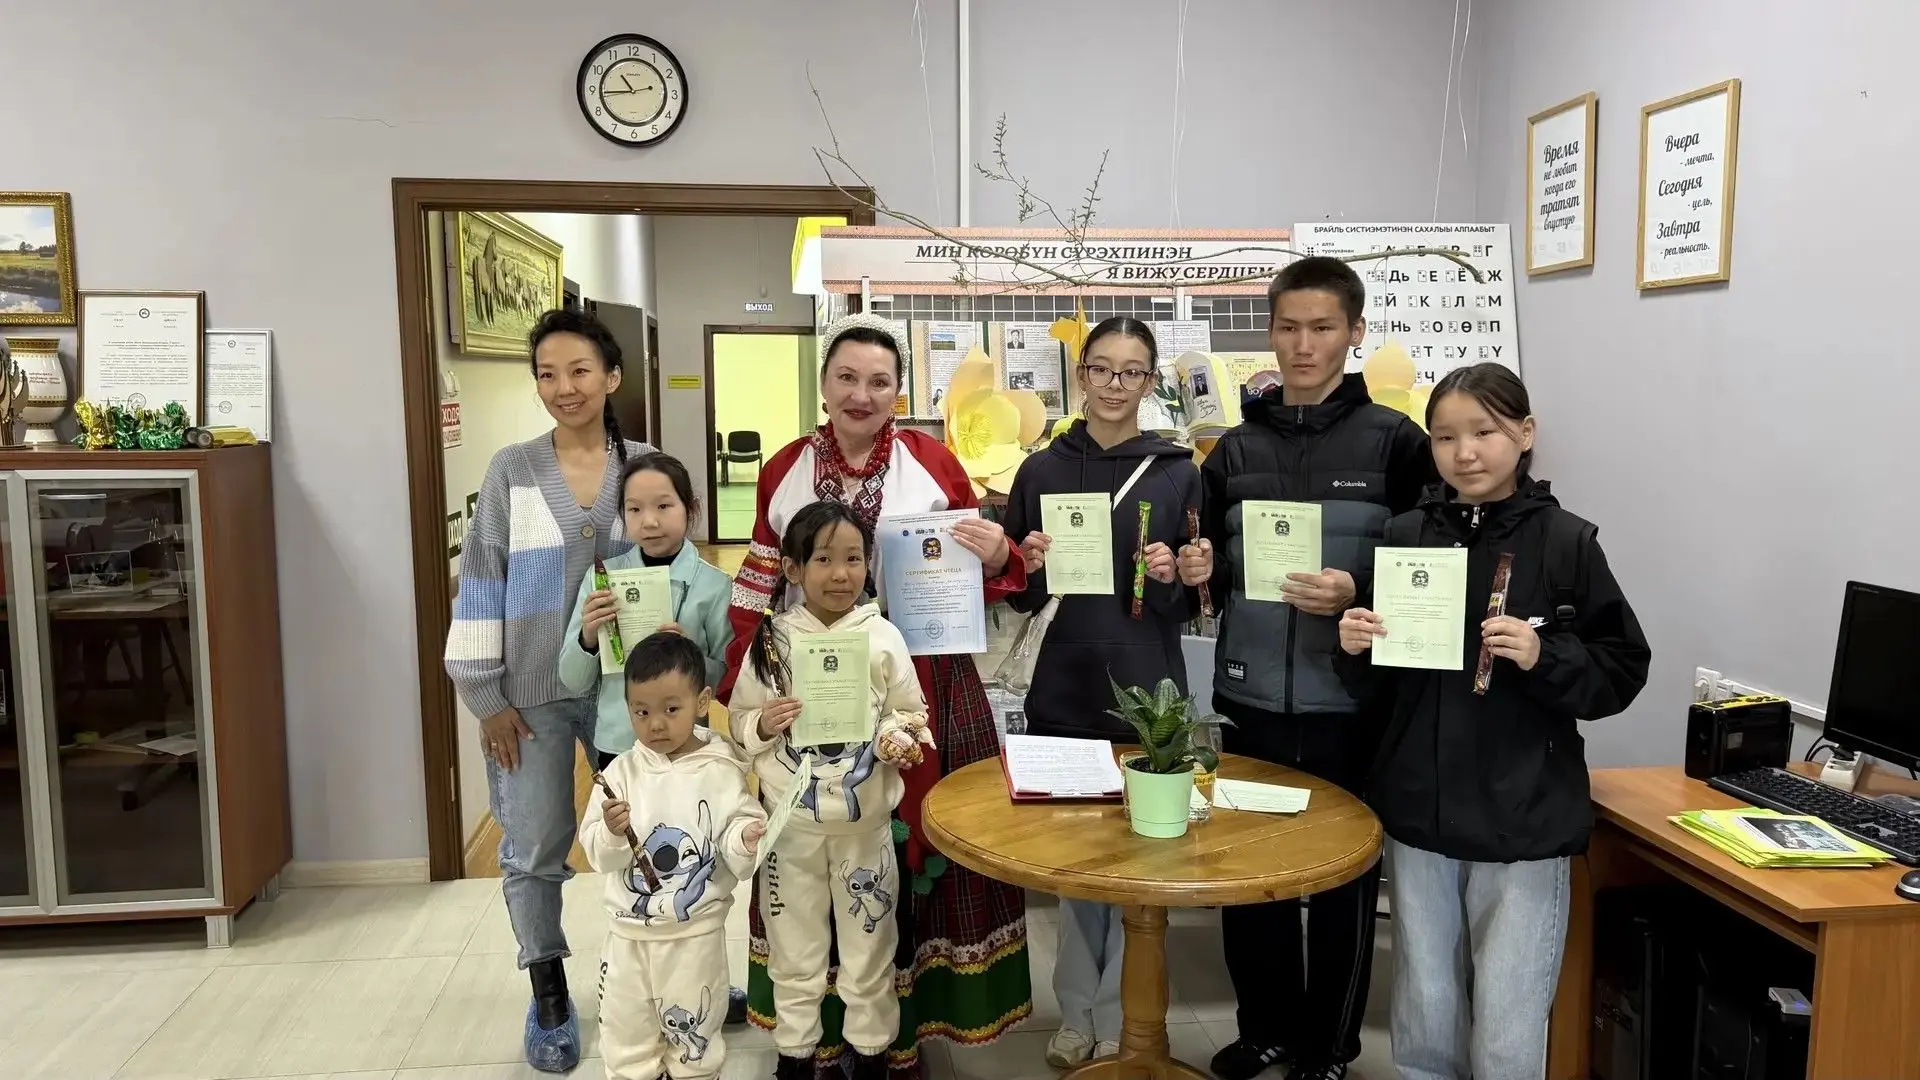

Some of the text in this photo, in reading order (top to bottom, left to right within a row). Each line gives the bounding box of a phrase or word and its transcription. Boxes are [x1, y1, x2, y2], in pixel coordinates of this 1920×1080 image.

[608, 50, 617, 60] 11
[627, 46, 639, 56] 12
[652, 54, 656, 63] 1
[593, 65, 603, 75] 10
[666, 69, 673, 79] 2
[589, 85, 596, 95] 9
[672, 90, 678, 100] 3
[596, 107, 602, 116] 8
[665, 111, 672, 120] 4
[612, 124, 618, 133] 7
[631, 129, 638, 139] 6
[651, 125, 658, 135] 5
[1665, 133, 1700, 152] Вчера
[1544, 141, 1579, 167] Время
[1544, 162, 1577, 181] не любит
[1544, 179, 1576, 196] когда его
[1658, 176, 1703, 196] Сегодня
[1540, 195, 1580, 217] тратят
[1544, 215, 1575, 232] впустую
[1657, 220, 1701, 239] Завтра
[916, 245, 962, 258] МИН
[1486, 245, 1493, 256] Г
[1107, 266, 1119, 279] Я
[1123, 266, 1180, 279] ВИЖУ
[1430, 271, 1437, 281] Е
[1459, 268, 1466, 281] Ё
[1487, 270, 1502, 281] Ж
[1386, 293, 1501, 307] Й К Л М
[1433, 321, 1443, 333] О
[1490, 321, 1500, 332] П
[1353, 347, 1362, 359] С
[1424, 346, 1433, 357] Т
[1457, 347, 1467, 358] У
[1425, 371, 1435, 383] Ч
[442, 406, 460, 425] ХОДЯ
[767, 850, 785, 916] Stitch
